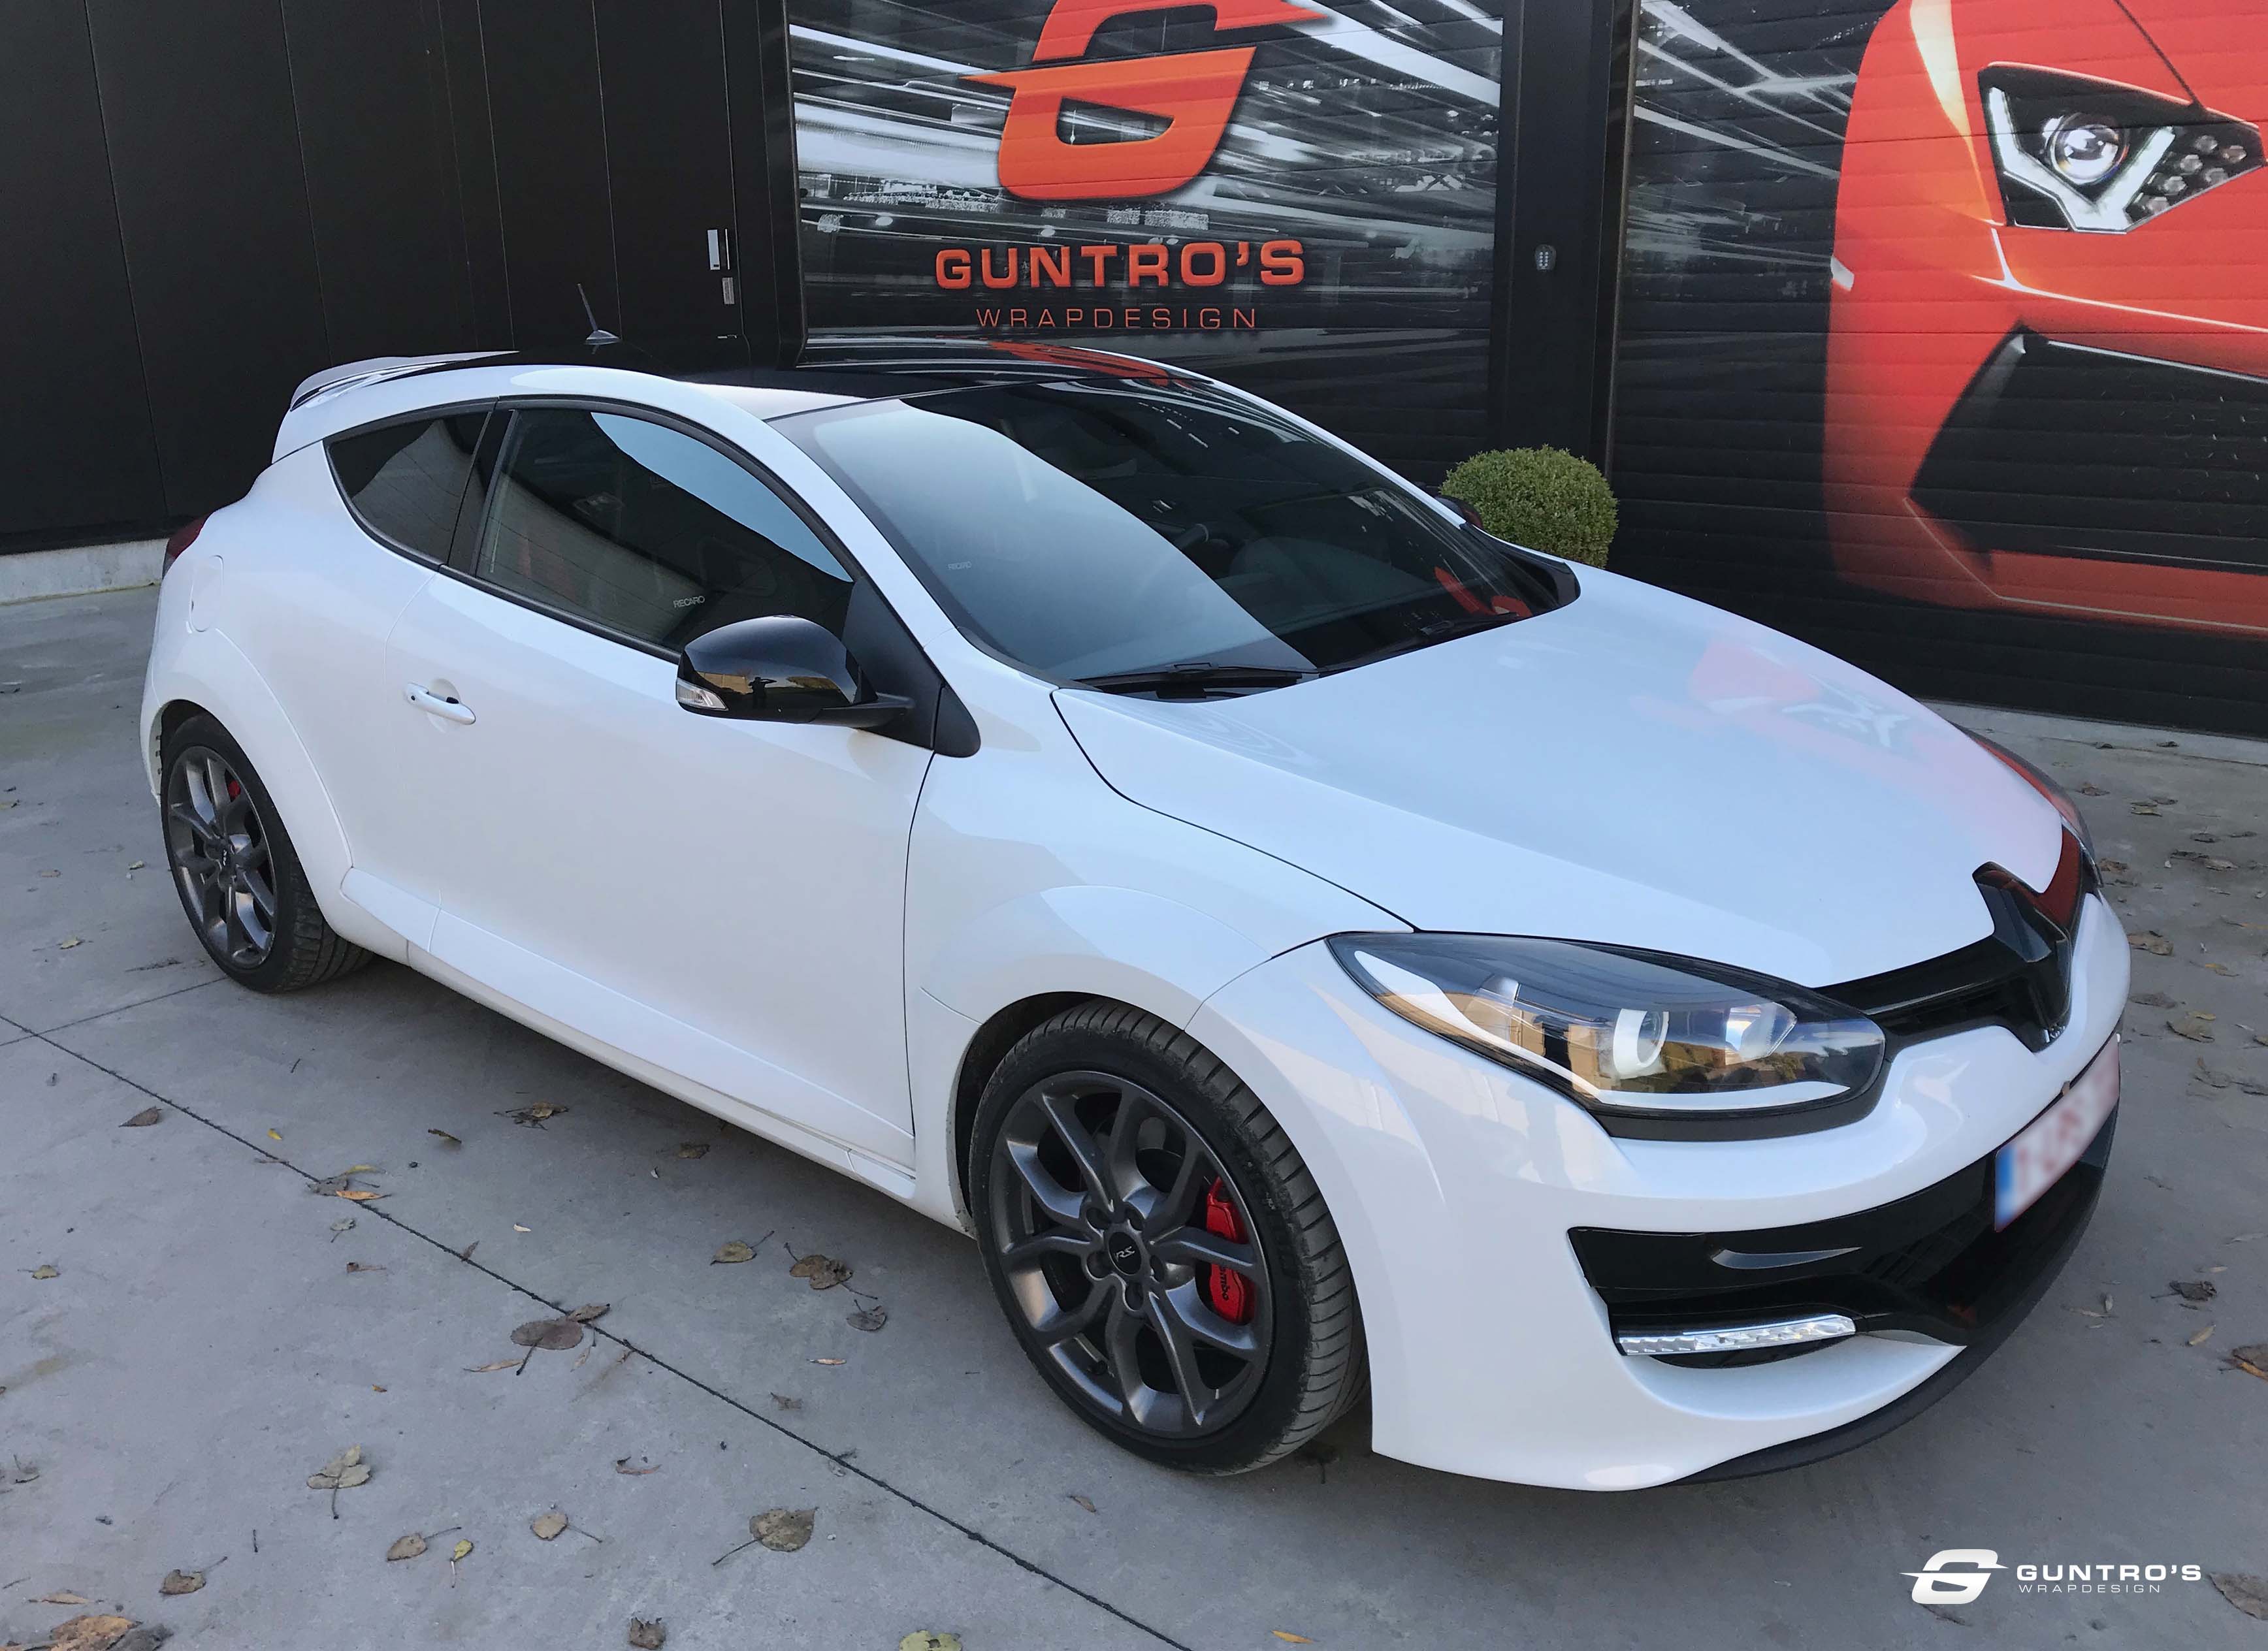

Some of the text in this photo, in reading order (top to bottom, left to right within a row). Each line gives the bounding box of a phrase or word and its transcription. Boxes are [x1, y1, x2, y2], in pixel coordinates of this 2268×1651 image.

[935, 239, 1305, 289] GUNTRO'S
[976, 308, 1256, 330] WRAPDESIGN
[673, 596, 705, 609] RECARO
